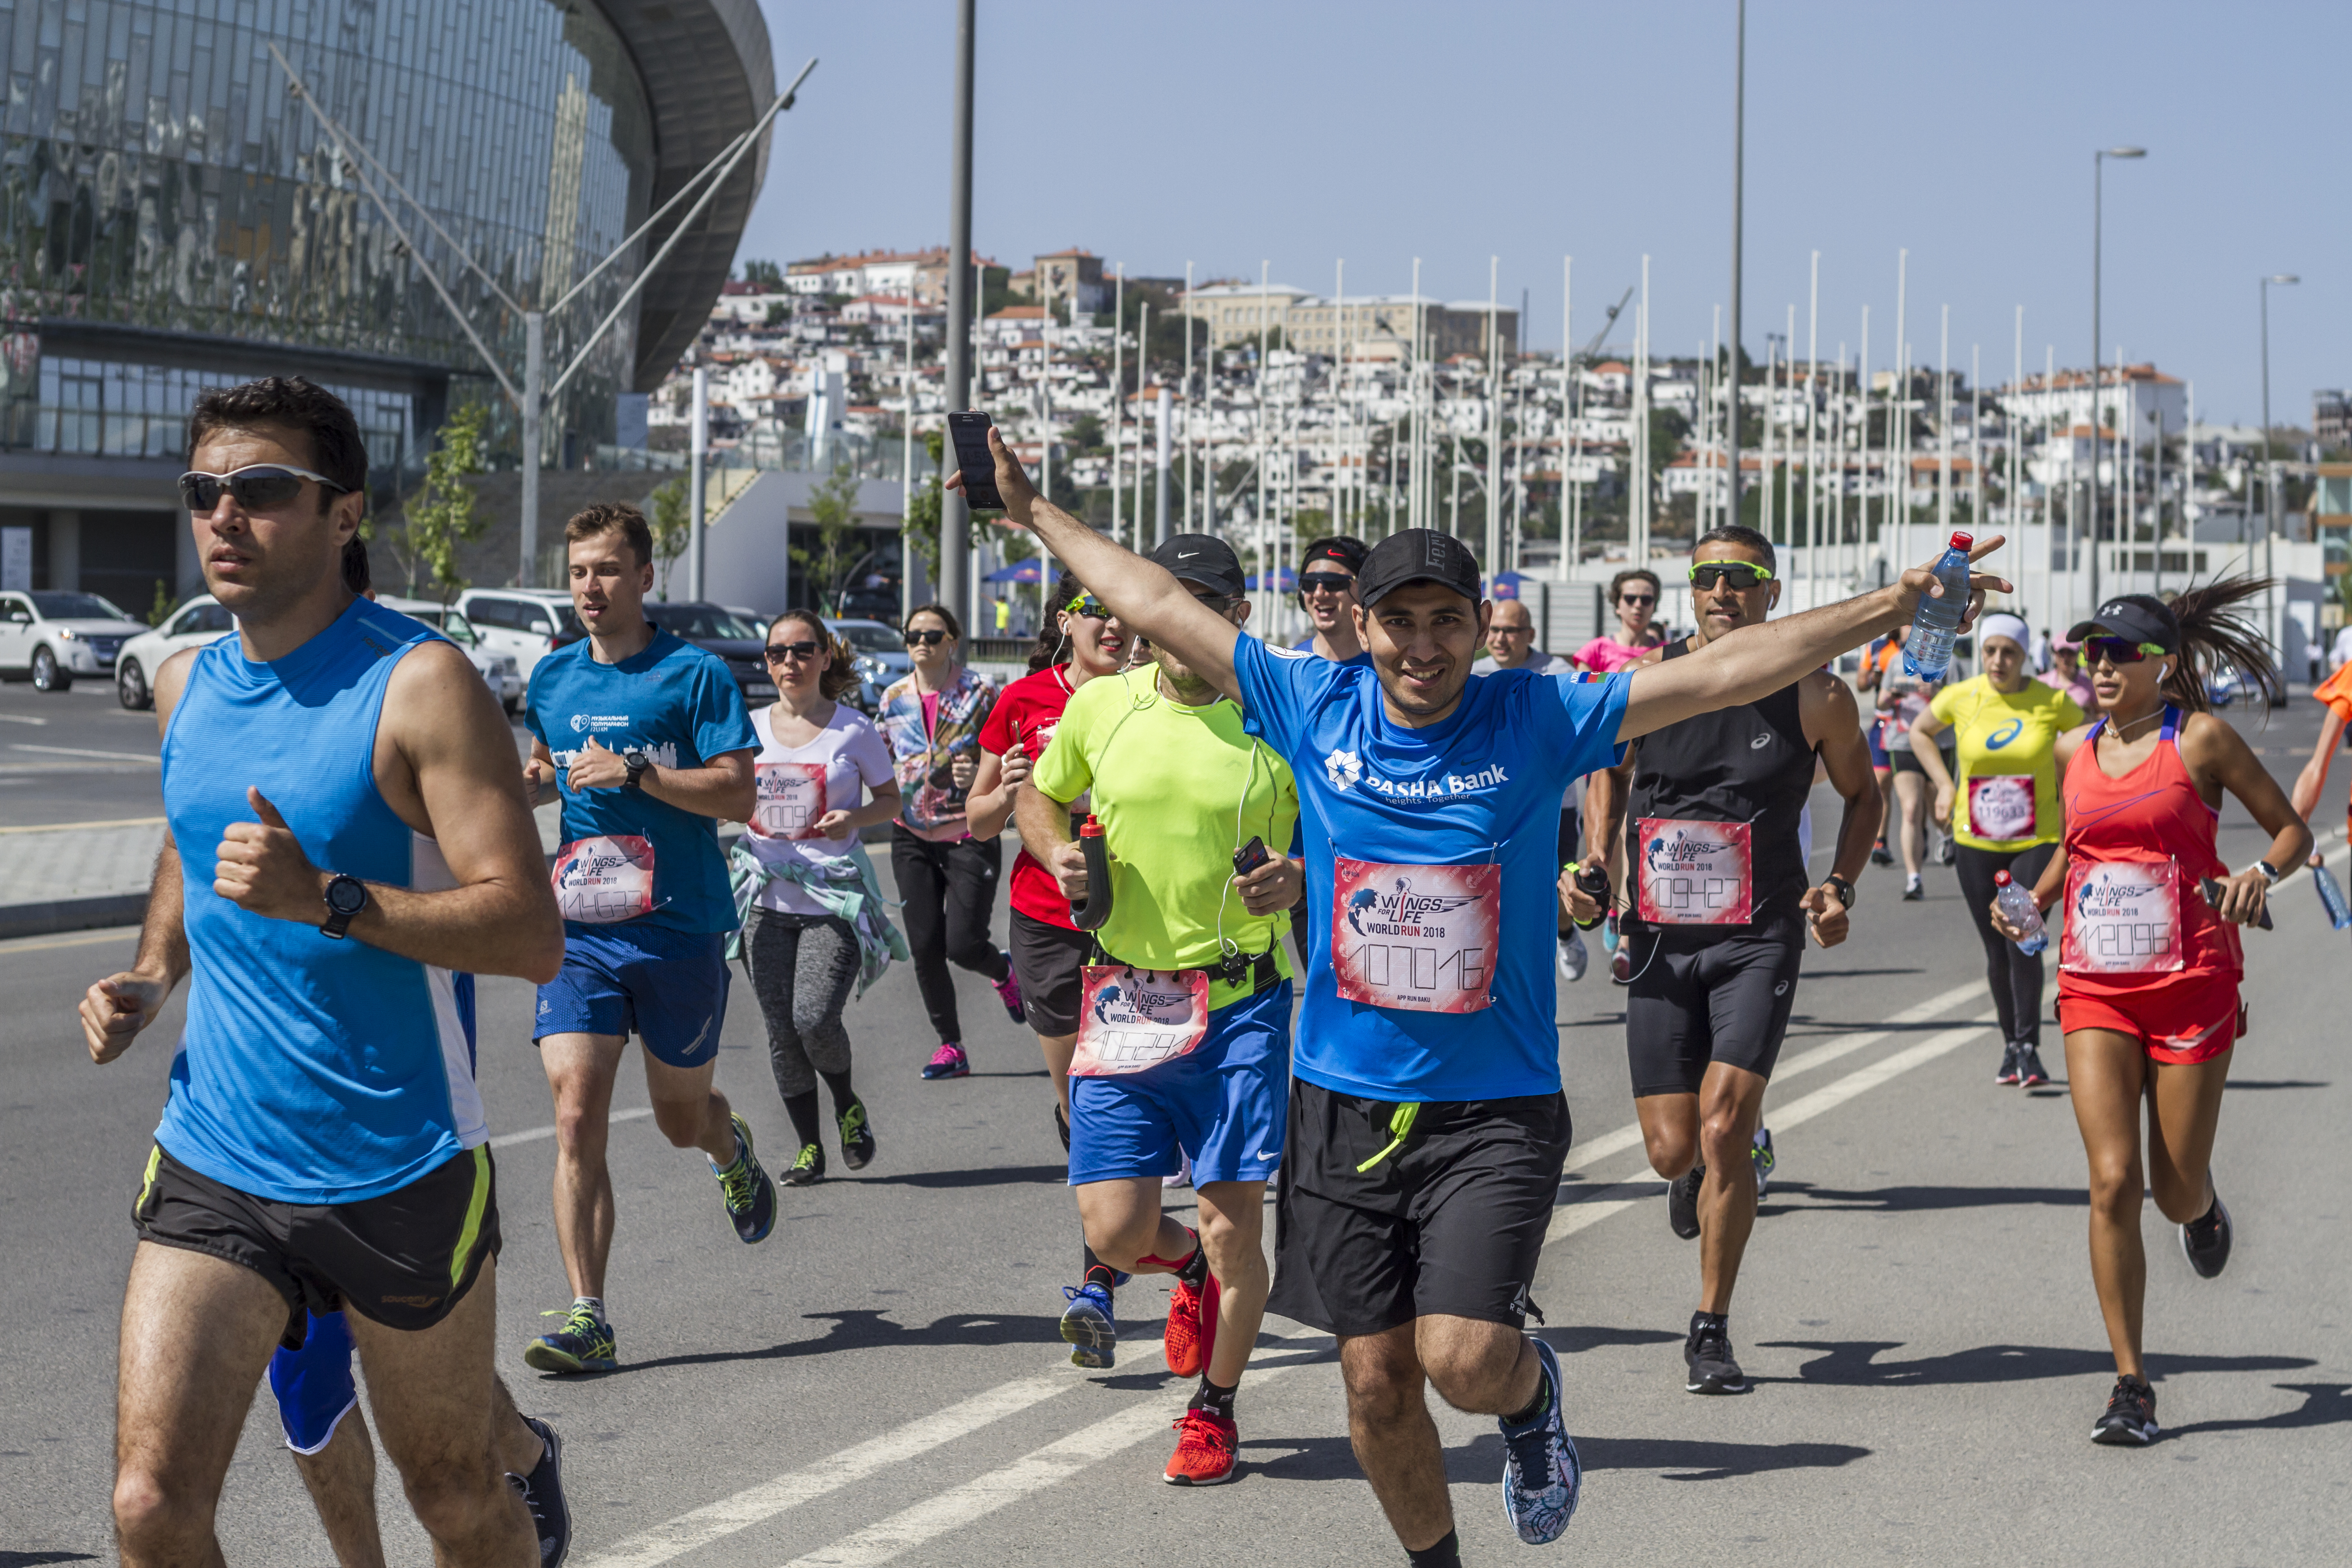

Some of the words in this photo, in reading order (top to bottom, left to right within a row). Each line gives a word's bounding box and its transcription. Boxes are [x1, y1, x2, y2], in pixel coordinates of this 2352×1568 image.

[1448, 764, 1509, 794] Bank
[1426, 793, 1473, 804] Together.
[1672, 852, 1698, 862] LIFE
[582, 867, 604, 876] LIFE
[1647, 877, 1740, 908] 109427
[2099, 897, 2122, 906] LIFE
[1389, 911, 1425, 924] LIFE
[2122, 908, 2138, 916] 2018
[1423, 927, 1445, 938] 2018
[2076, 922, 2170, 956] 112096
[1348, 944, 1484, 991] 107016
[1128, 1002, 1154, 1014] LIFE
[1153, 1017, 1169, 1025] 2018
[1091, 1030, 1192, 1061] 106291
